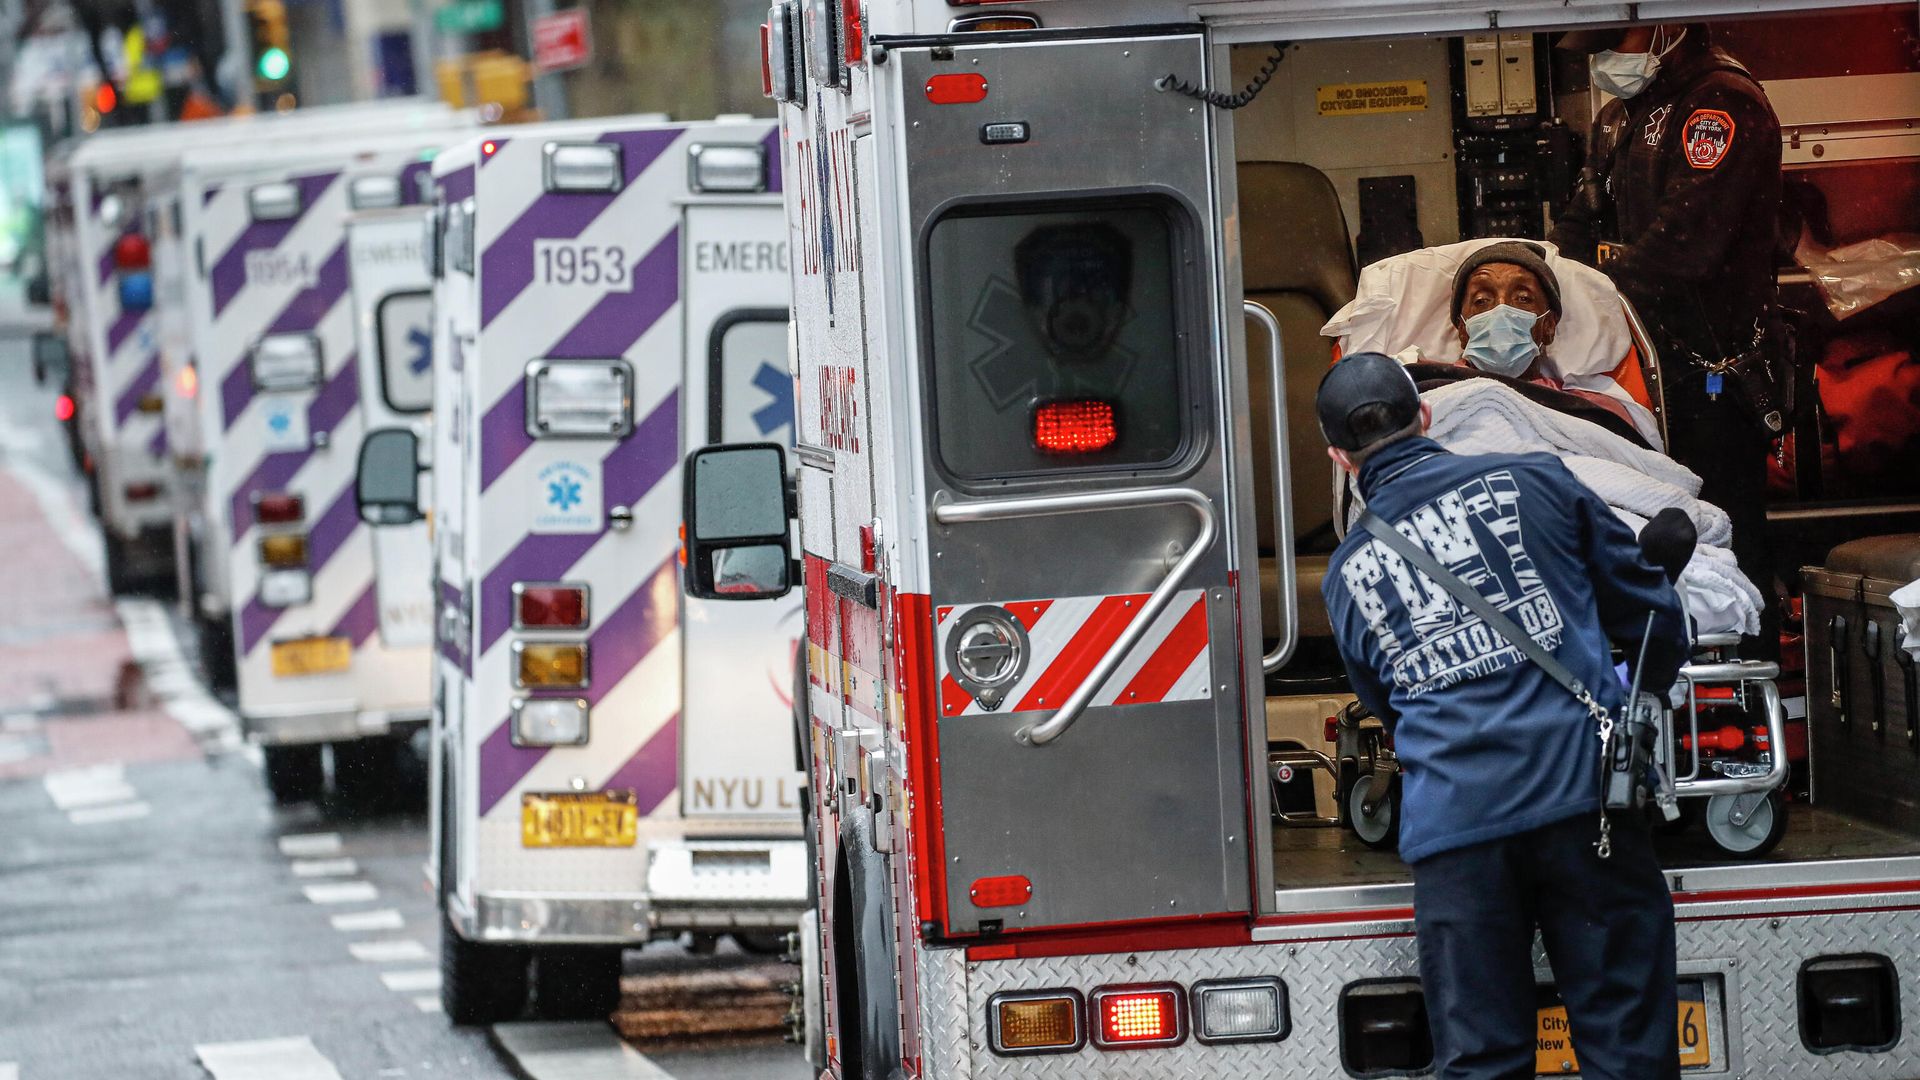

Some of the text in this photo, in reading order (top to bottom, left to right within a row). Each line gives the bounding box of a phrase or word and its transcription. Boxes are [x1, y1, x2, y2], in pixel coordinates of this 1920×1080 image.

[1320, 95, 1426, 111] OXYGEN EQUIPPED
[1336, 85, 1408, 99] NO SMOKING
[1701, 114, 1729, 130] DEPARTMENT
[541, 246, 626, 286] 1953
[695, 241, 788, 272] EMERG
[1340, 470, 1546, 664] FDNY
[1517, 595, 1557, 635] 08
[1467, 656, 1507, 680] STILL
[694, 777, 763, 810] NYU
[1542, 1017, 1571, 1033] City
[1683, 1006, 1699, 1047] 6
[1536, 1038, 1564, 1050] New
